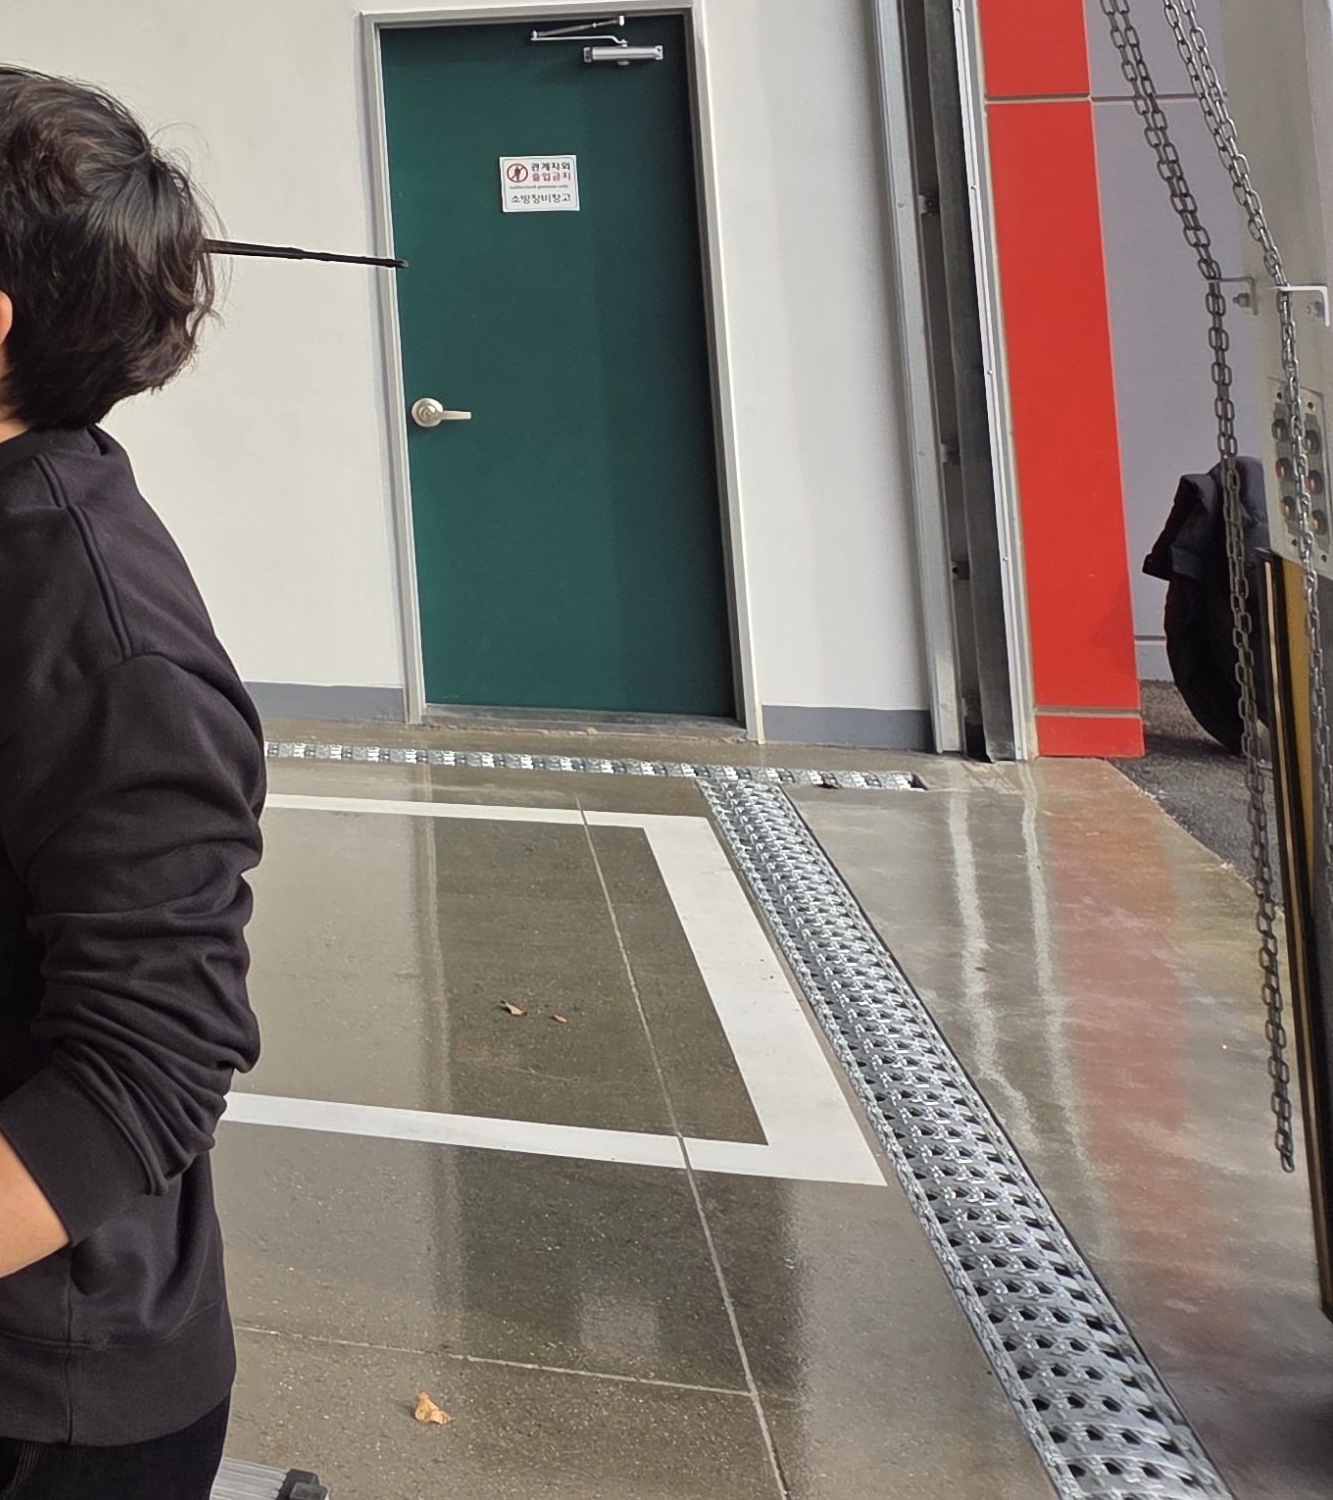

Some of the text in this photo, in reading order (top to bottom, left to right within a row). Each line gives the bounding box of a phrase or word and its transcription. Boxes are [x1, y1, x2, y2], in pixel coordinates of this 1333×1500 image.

[531, 162, 571, 172] 관계자외
[532, 172, 571, 181] 출입금지
[511, 193, 572, 204] 소방장비창고
